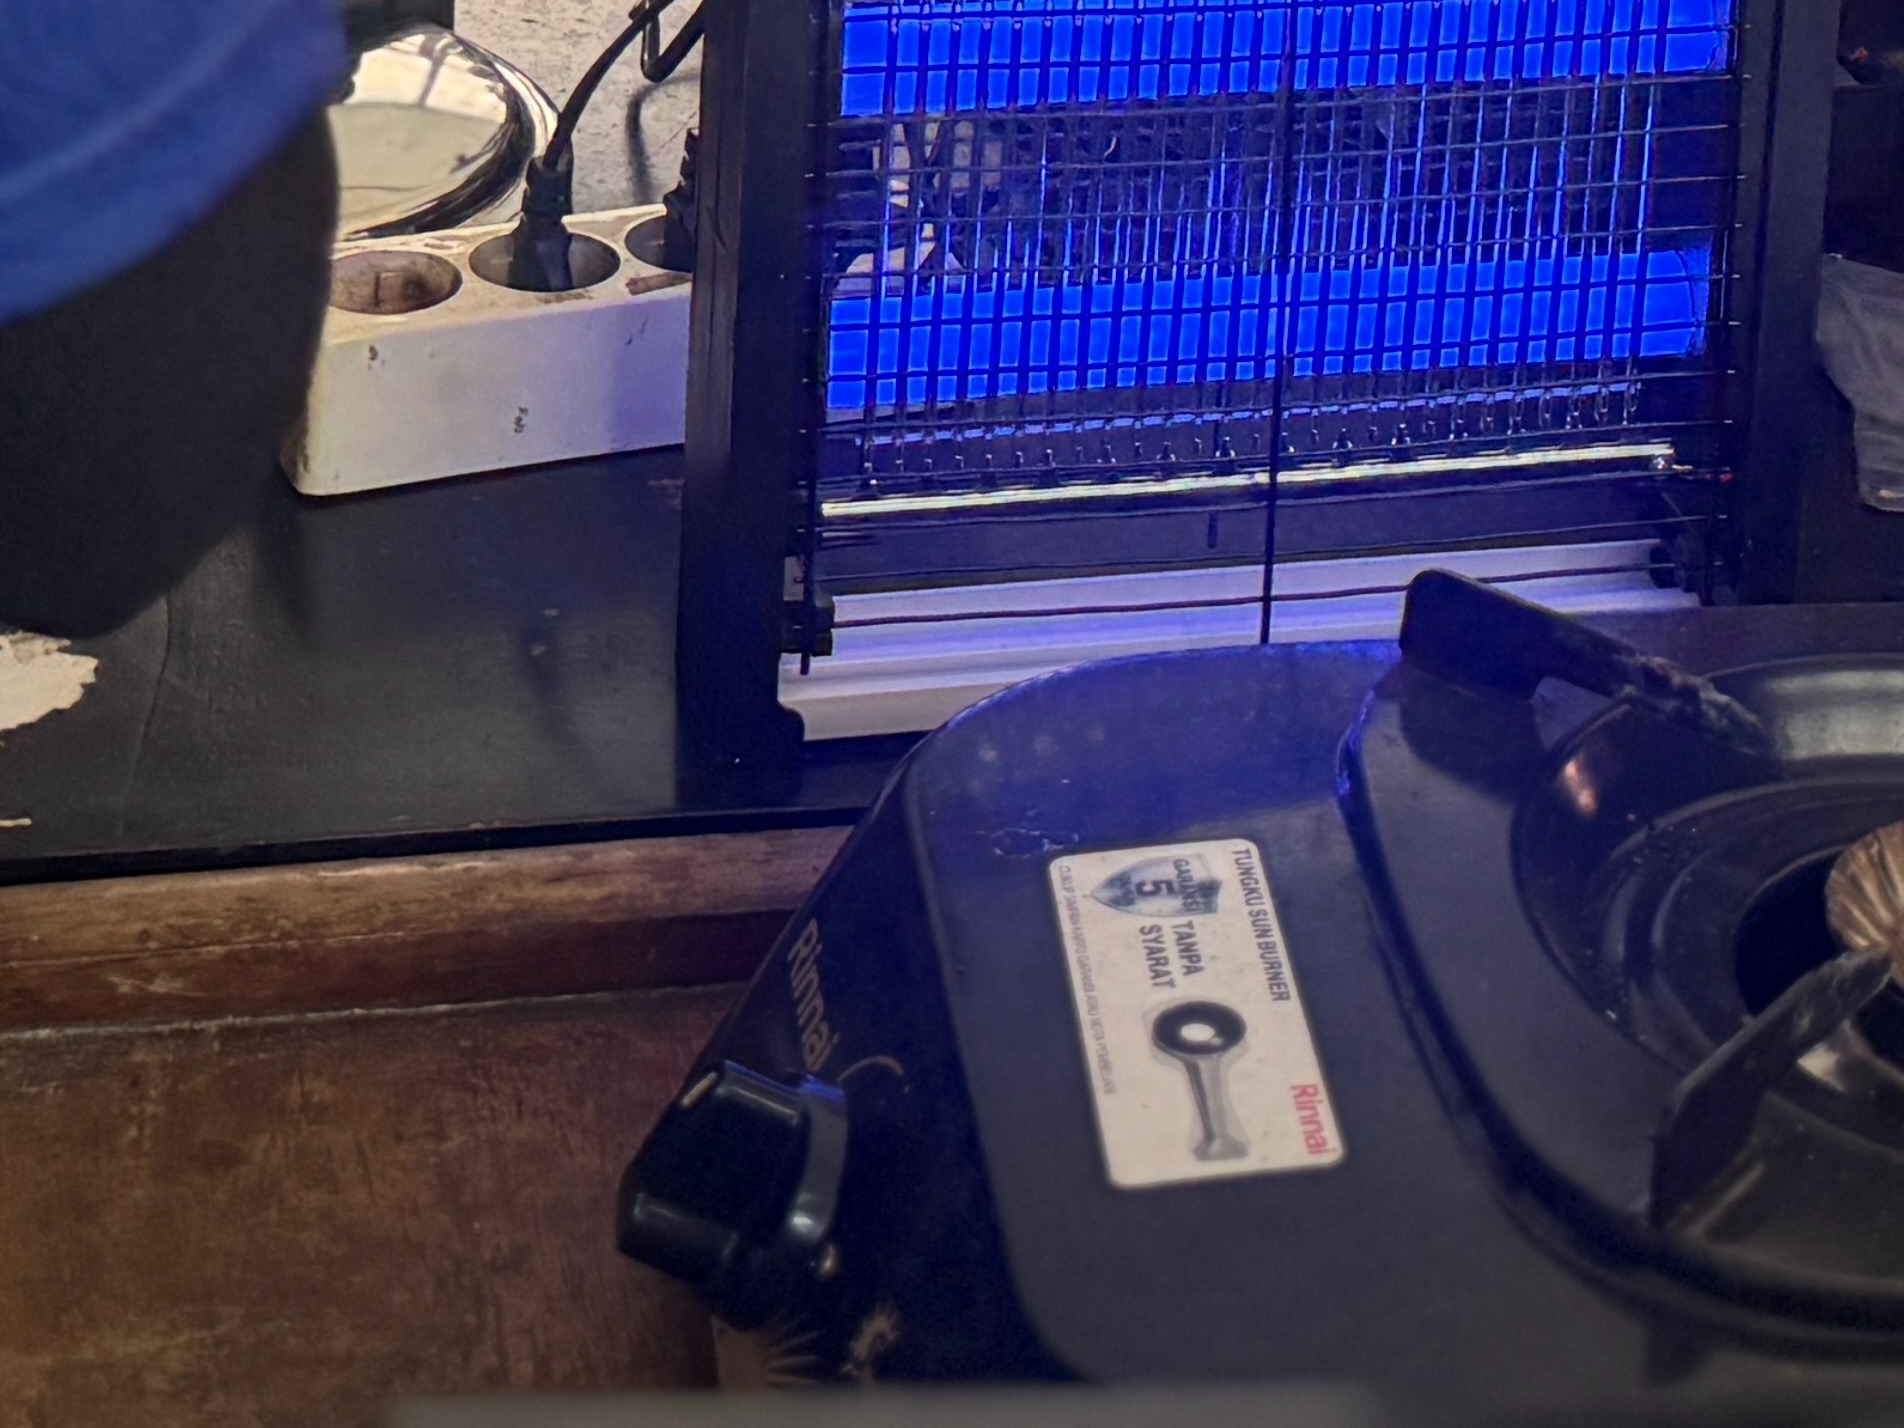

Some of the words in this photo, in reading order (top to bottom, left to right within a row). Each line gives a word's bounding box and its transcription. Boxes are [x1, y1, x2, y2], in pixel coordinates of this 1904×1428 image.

[1136, 879, 1174, 897] 5
[1173, 858, 1202, 912] GARANSI
[1232, 848, 1265, 906] TUNGKU
[1171, 921, 1204, 976] TANPA
[1249, 909, 1273, 939] SUN
[1139, 924, 1176, 988] SYARAT
[1257, 941, 1291, 1002] BURNER
[787, 918, 840, 1071] Rinnai
[1289, 1084, 1337, 1155] Rinnai
